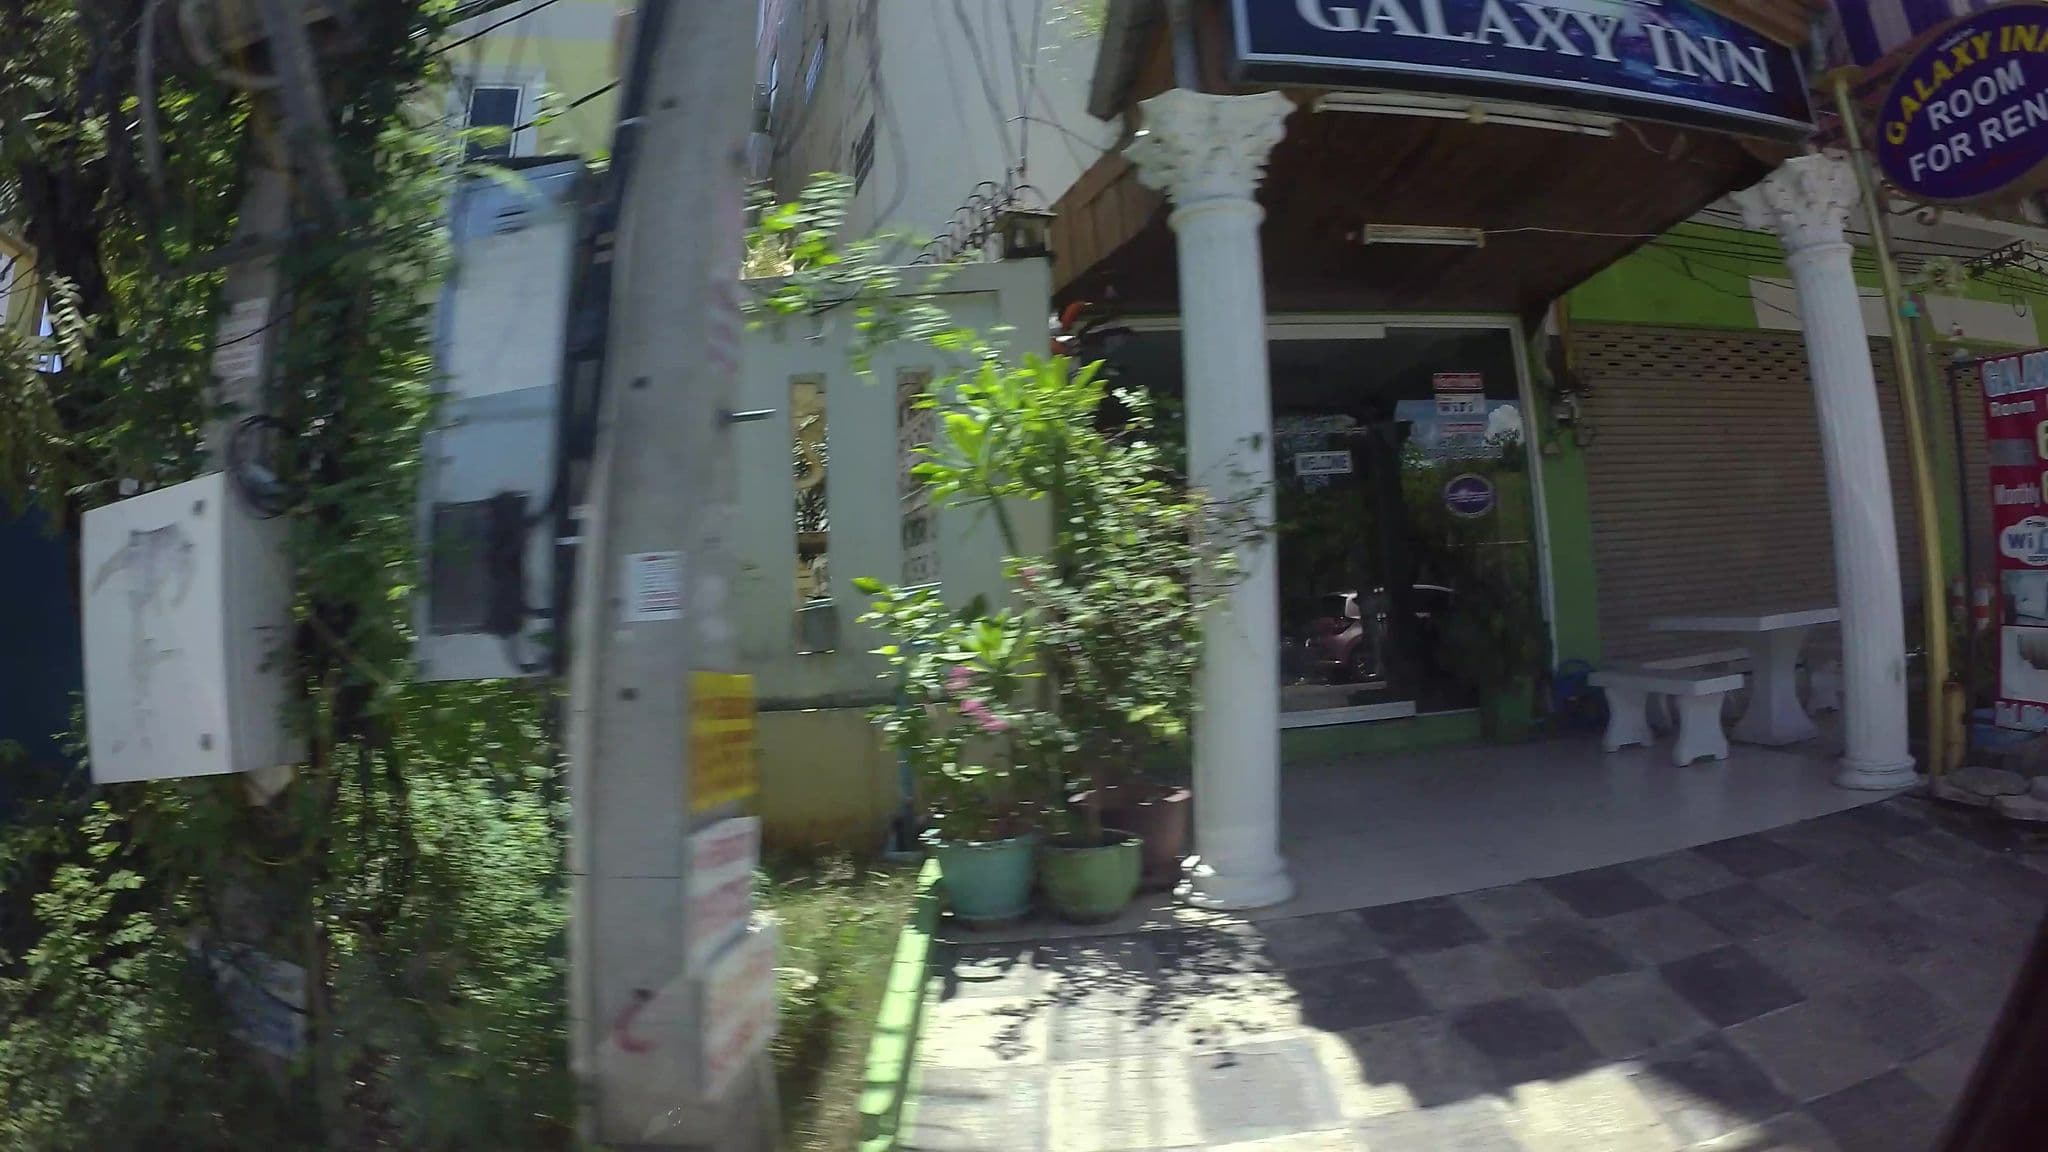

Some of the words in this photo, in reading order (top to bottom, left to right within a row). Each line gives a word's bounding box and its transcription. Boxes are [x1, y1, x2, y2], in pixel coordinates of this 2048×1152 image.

[1295, 0, 1620, 63] GALAXY
[1642, 23, 1774, 94] INN
[1885, 30, 1993, 145] GALAXY
[1908, 132, 1976, 182] FOR
[1978, 87, 2048, 149] REN
[1927, 58, 2026, 131] ROOM
